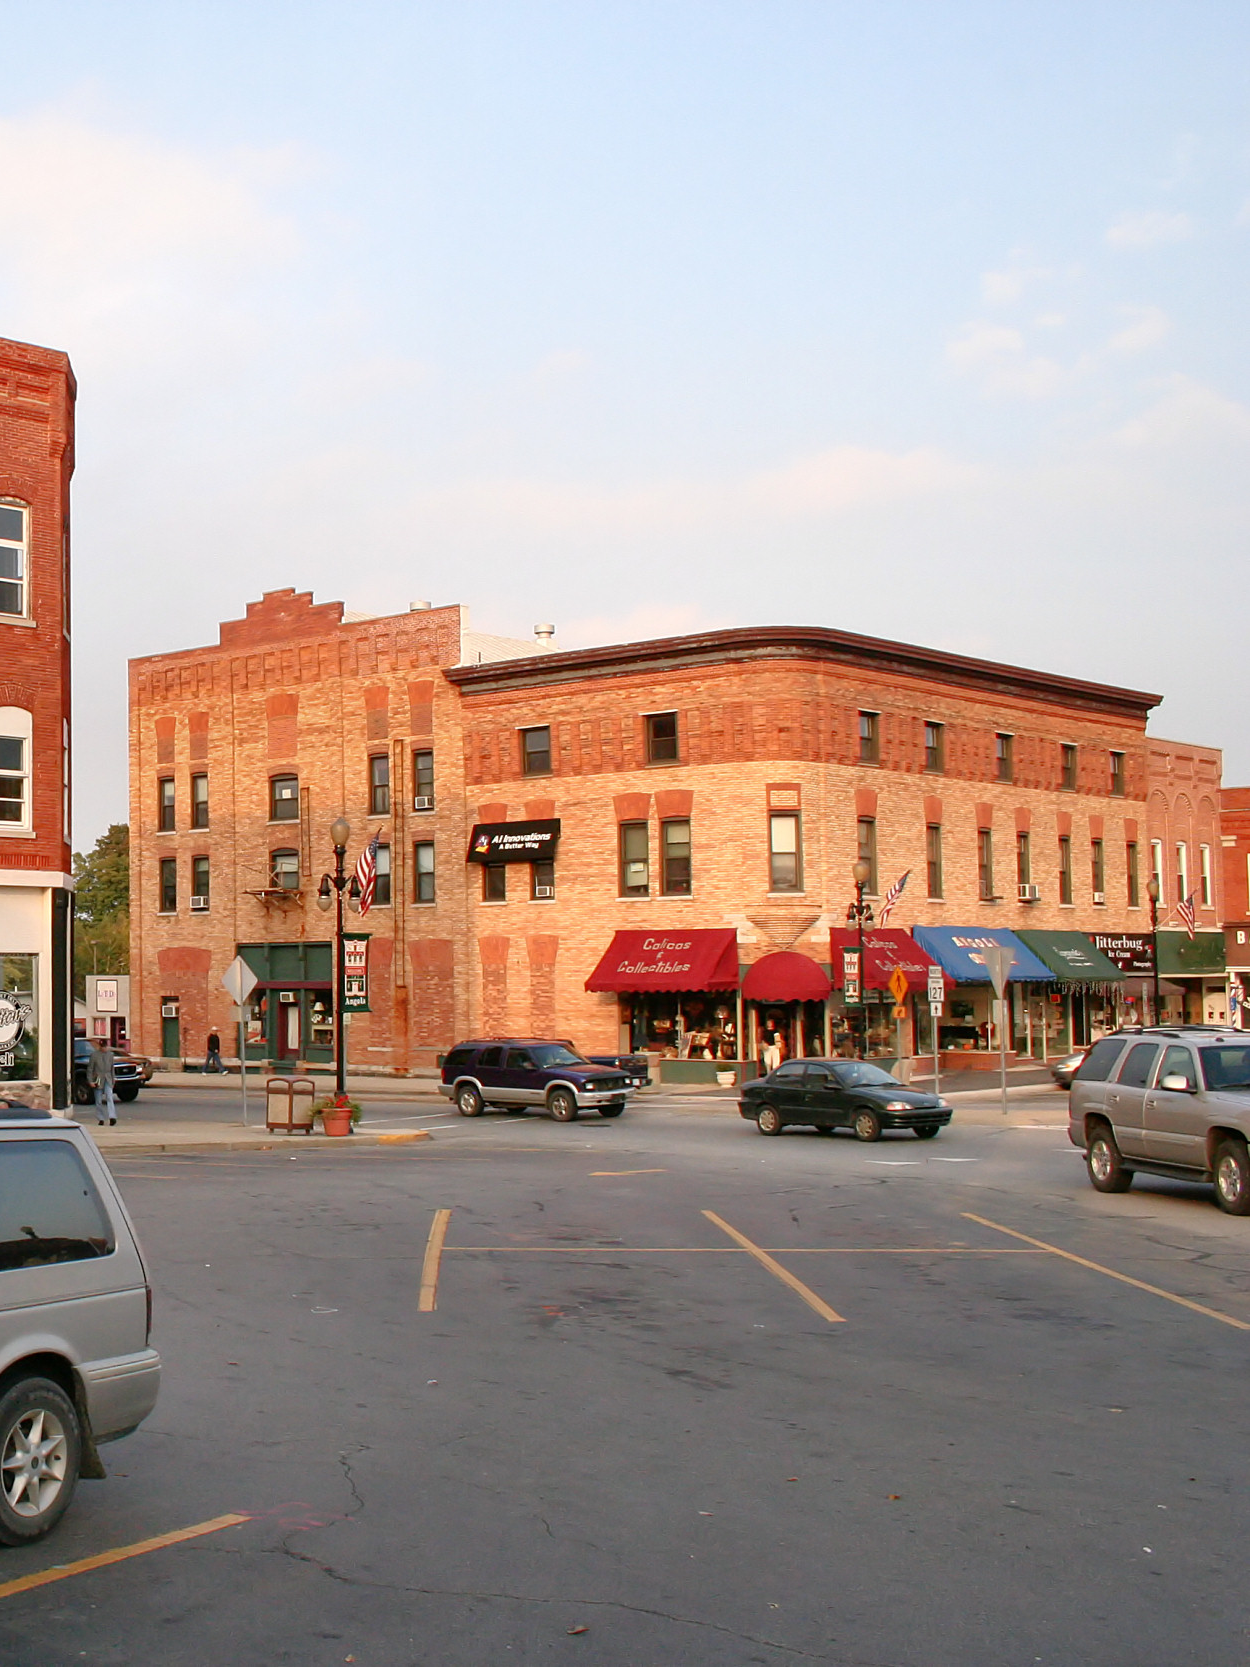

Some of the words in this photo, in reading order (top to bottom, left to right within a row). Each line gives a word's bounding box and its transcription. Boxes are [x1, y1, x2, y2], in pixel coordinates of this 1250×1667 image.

[503, 832, 551, 843] Innovations
[505, 842, 524, 850] Better
[1095, 935, 1143, 951] Jitterbug
[1108, 950, 1116, 958] Ice
[1116, 950, 1131, 958] Cream
[616, 960, 691, 974] Collectibles
[929, 987, 943, 1000] 127
[345, 997, 366, 1006] Angola
